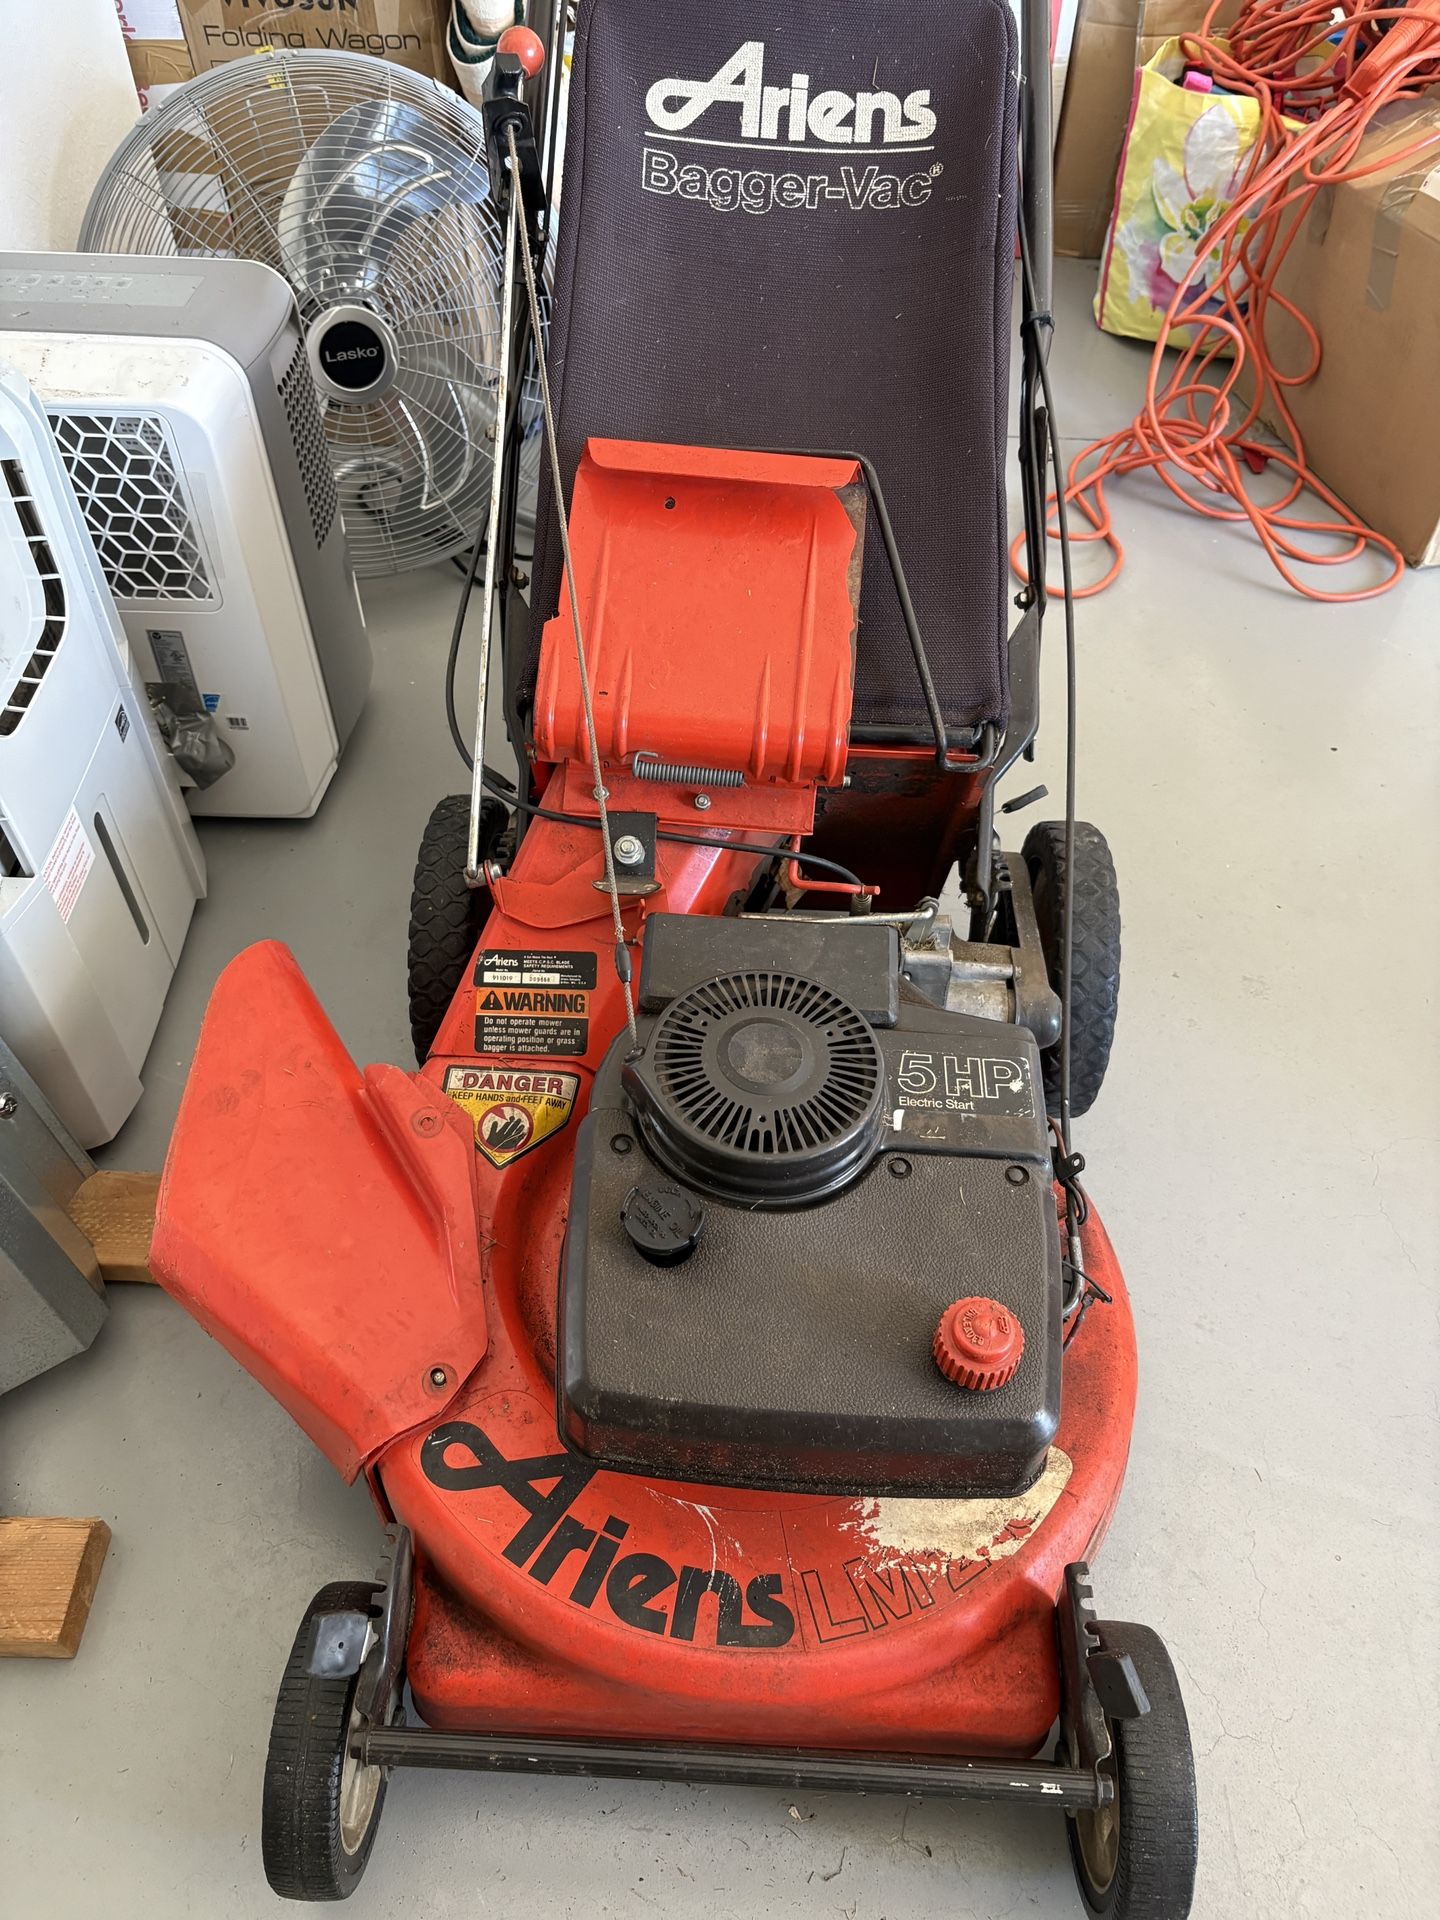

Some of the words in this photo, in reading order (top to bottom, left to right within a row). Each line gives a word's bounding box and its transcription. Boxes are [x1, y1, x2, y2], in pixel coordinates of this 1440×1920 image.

[203, 25, 304, 48] Folding
[316, 28, 421, 55] Wagon
[645, 41, 937, 143] Ariens
[484, 954, 519, 967] Ariens
[503, 992, 585, 1014] WARNING
[484, 1017, 493, 1025] Do
[510, 1018, 535, 1027] operate
[483, 1035, 515, 1044] operating
[517, 1035, 545, 1044] position
[557, 1037, 575, 1045] grass
[534, 1027, 557, 1036] guards
[483, 1044, 507, 1053] bagger
[517, 1045, 550, 1053] attached.
[462, 1073, 563, 1096] DANGER
[898, 1053, 936, 1094] 5
[943, 1056, 1022, 1099] HP
[452, 1092, 474, 1101] KEEP
[475, 1093, 504, 1103] HANDS
[545, 1098, 567, 1110] AWAY
[899, 1096, 943, 1109] Electric
[945, 1099, 975, 1110] Start
[420, 1421, 795, 1648] Ariens
